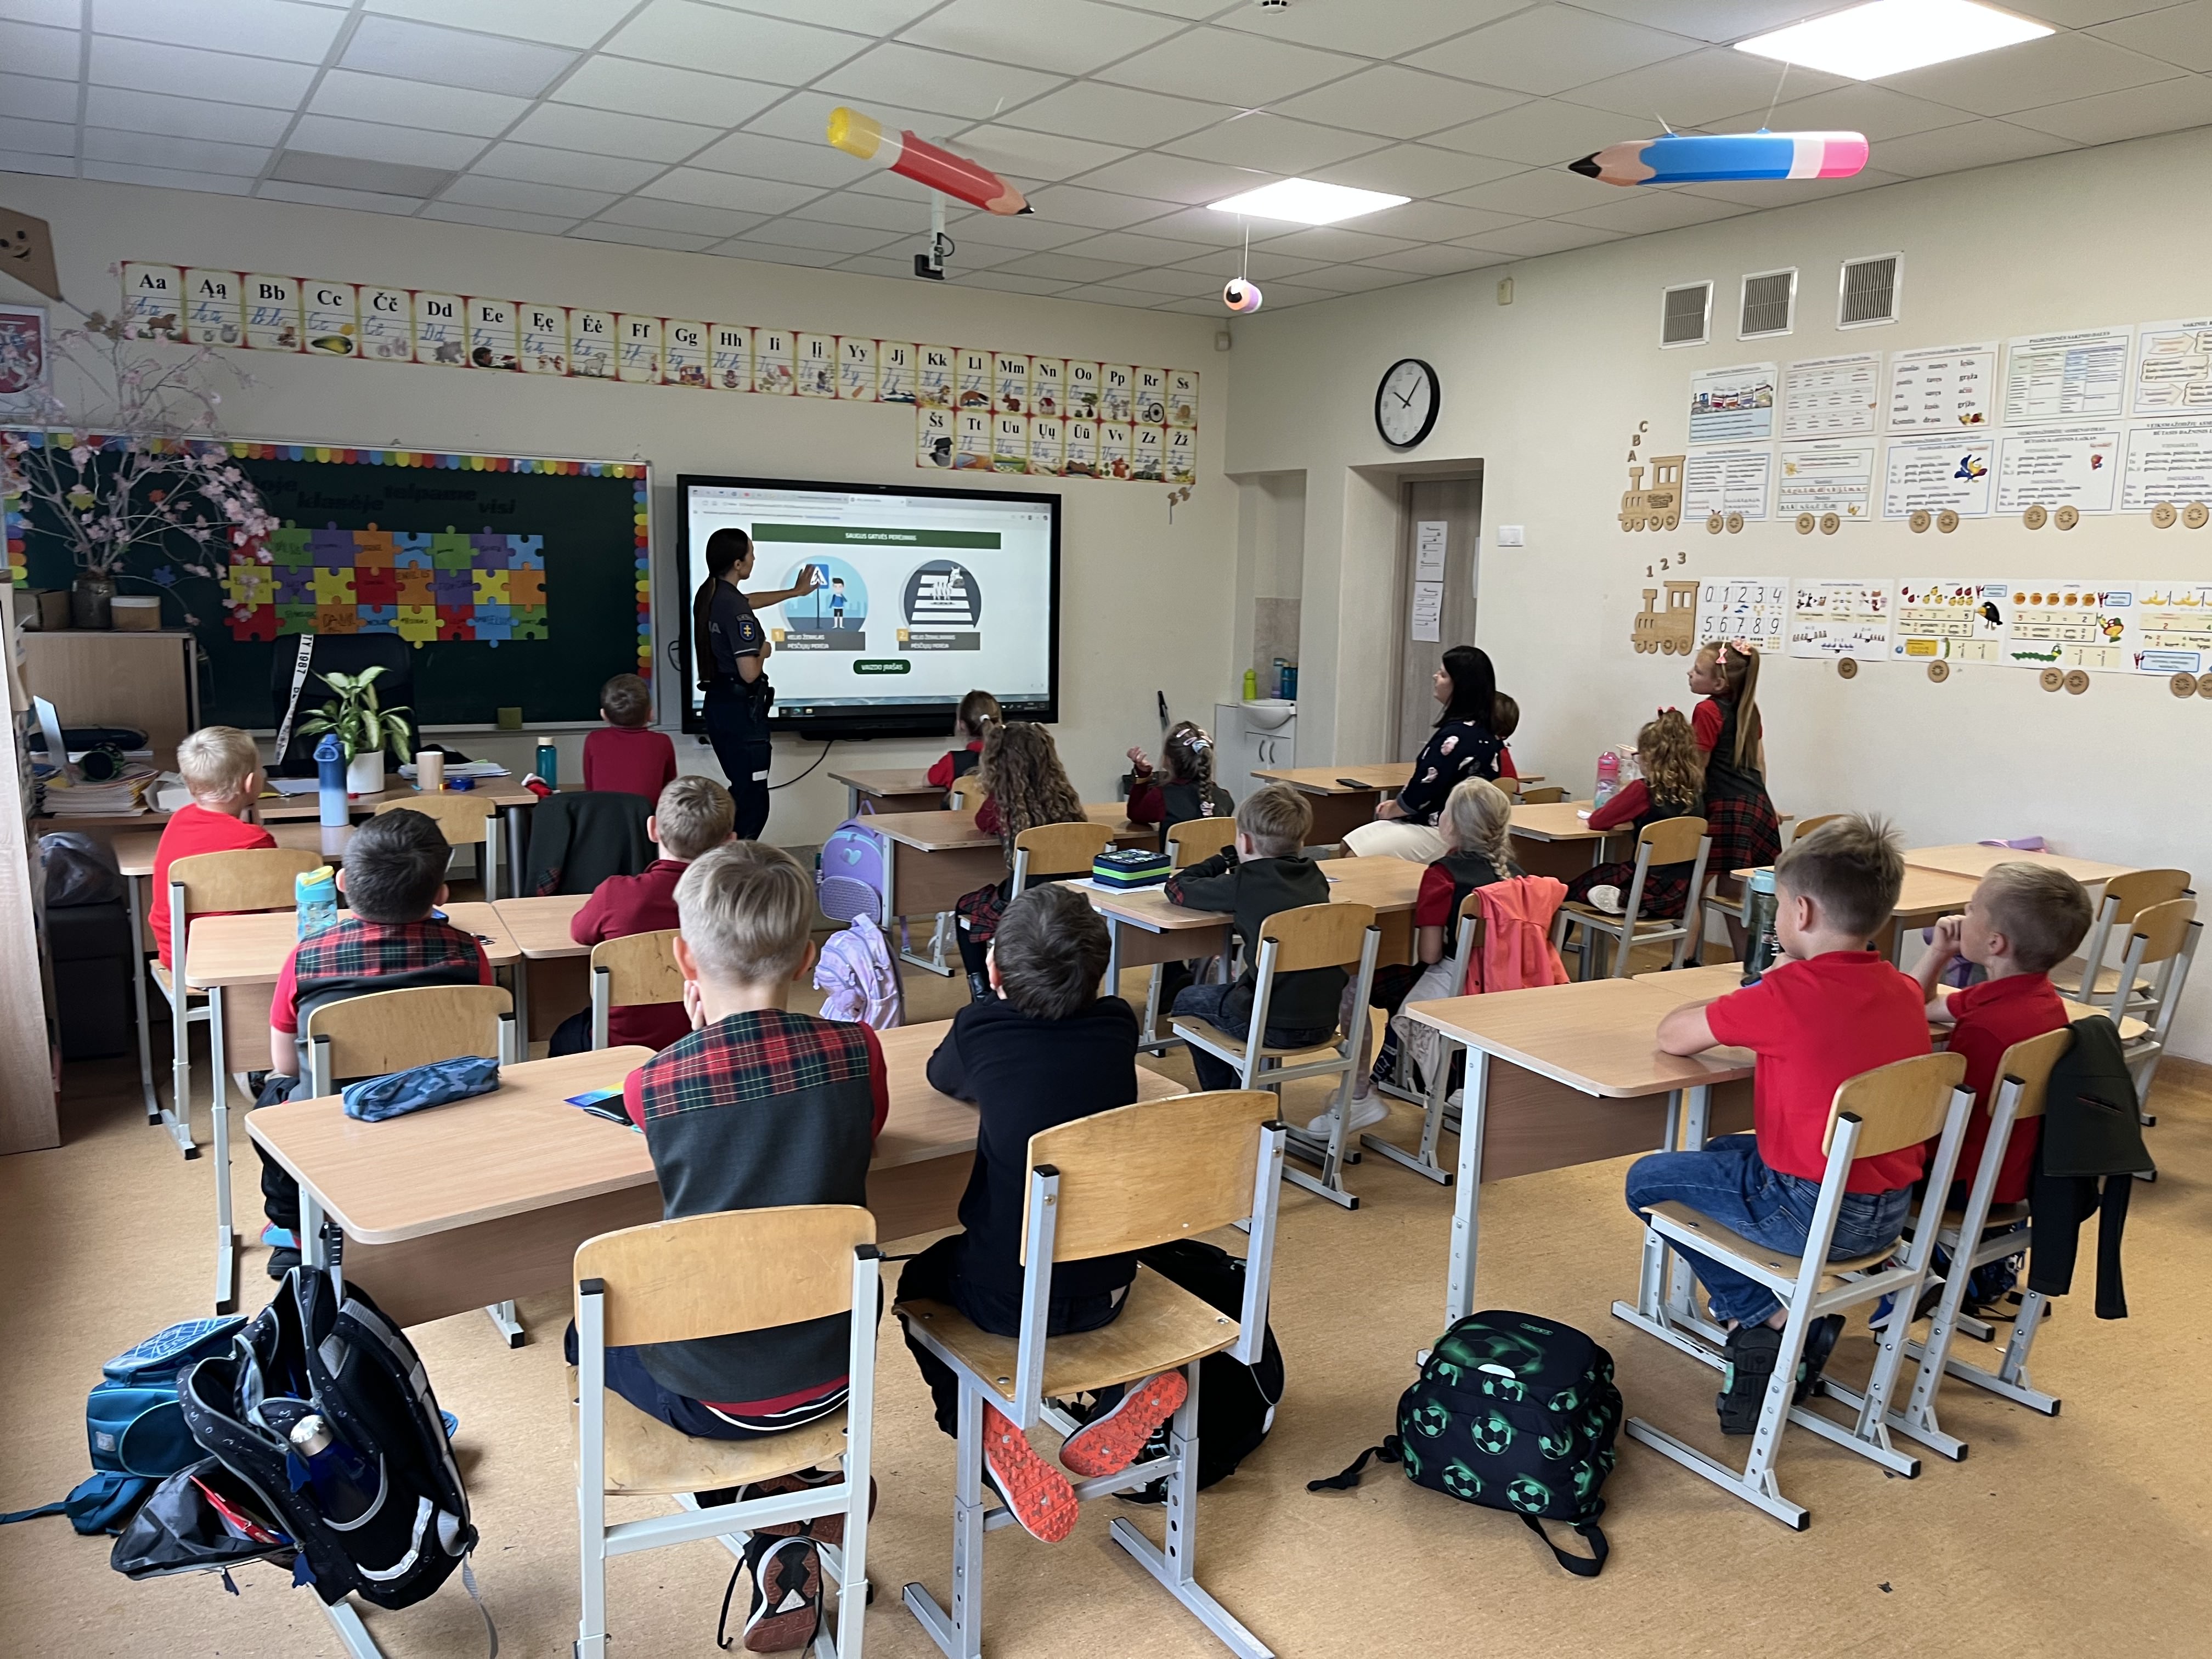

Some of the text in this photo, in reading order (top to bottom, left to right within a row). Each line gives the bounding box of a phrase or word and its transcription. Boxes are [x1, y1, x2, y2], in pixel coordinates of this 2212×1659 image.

[139, 274, 1189, 390] Aa Ąą Bb Cc Čč Dd Ee Ęę Ėė Ff Gg Hh Ii Įį Yy Jj Kk Ll Mm Nn Oo Pp Rr Ss
[929, 413, 1188, 446] Šš Tt Uu Ųų Ūū Vv Zz Žž
[1627, 420, 1648, 462] A B C
[478, 499, 516, 515] visi
[1646, 552, 1686, 577] 1 2 3
[1706, 586, 1782, 603] 0 1 2 3 4
[1704, 617, 1779, 634] 5 6 7 8 9
[297, 652, 309, 674] 1987
